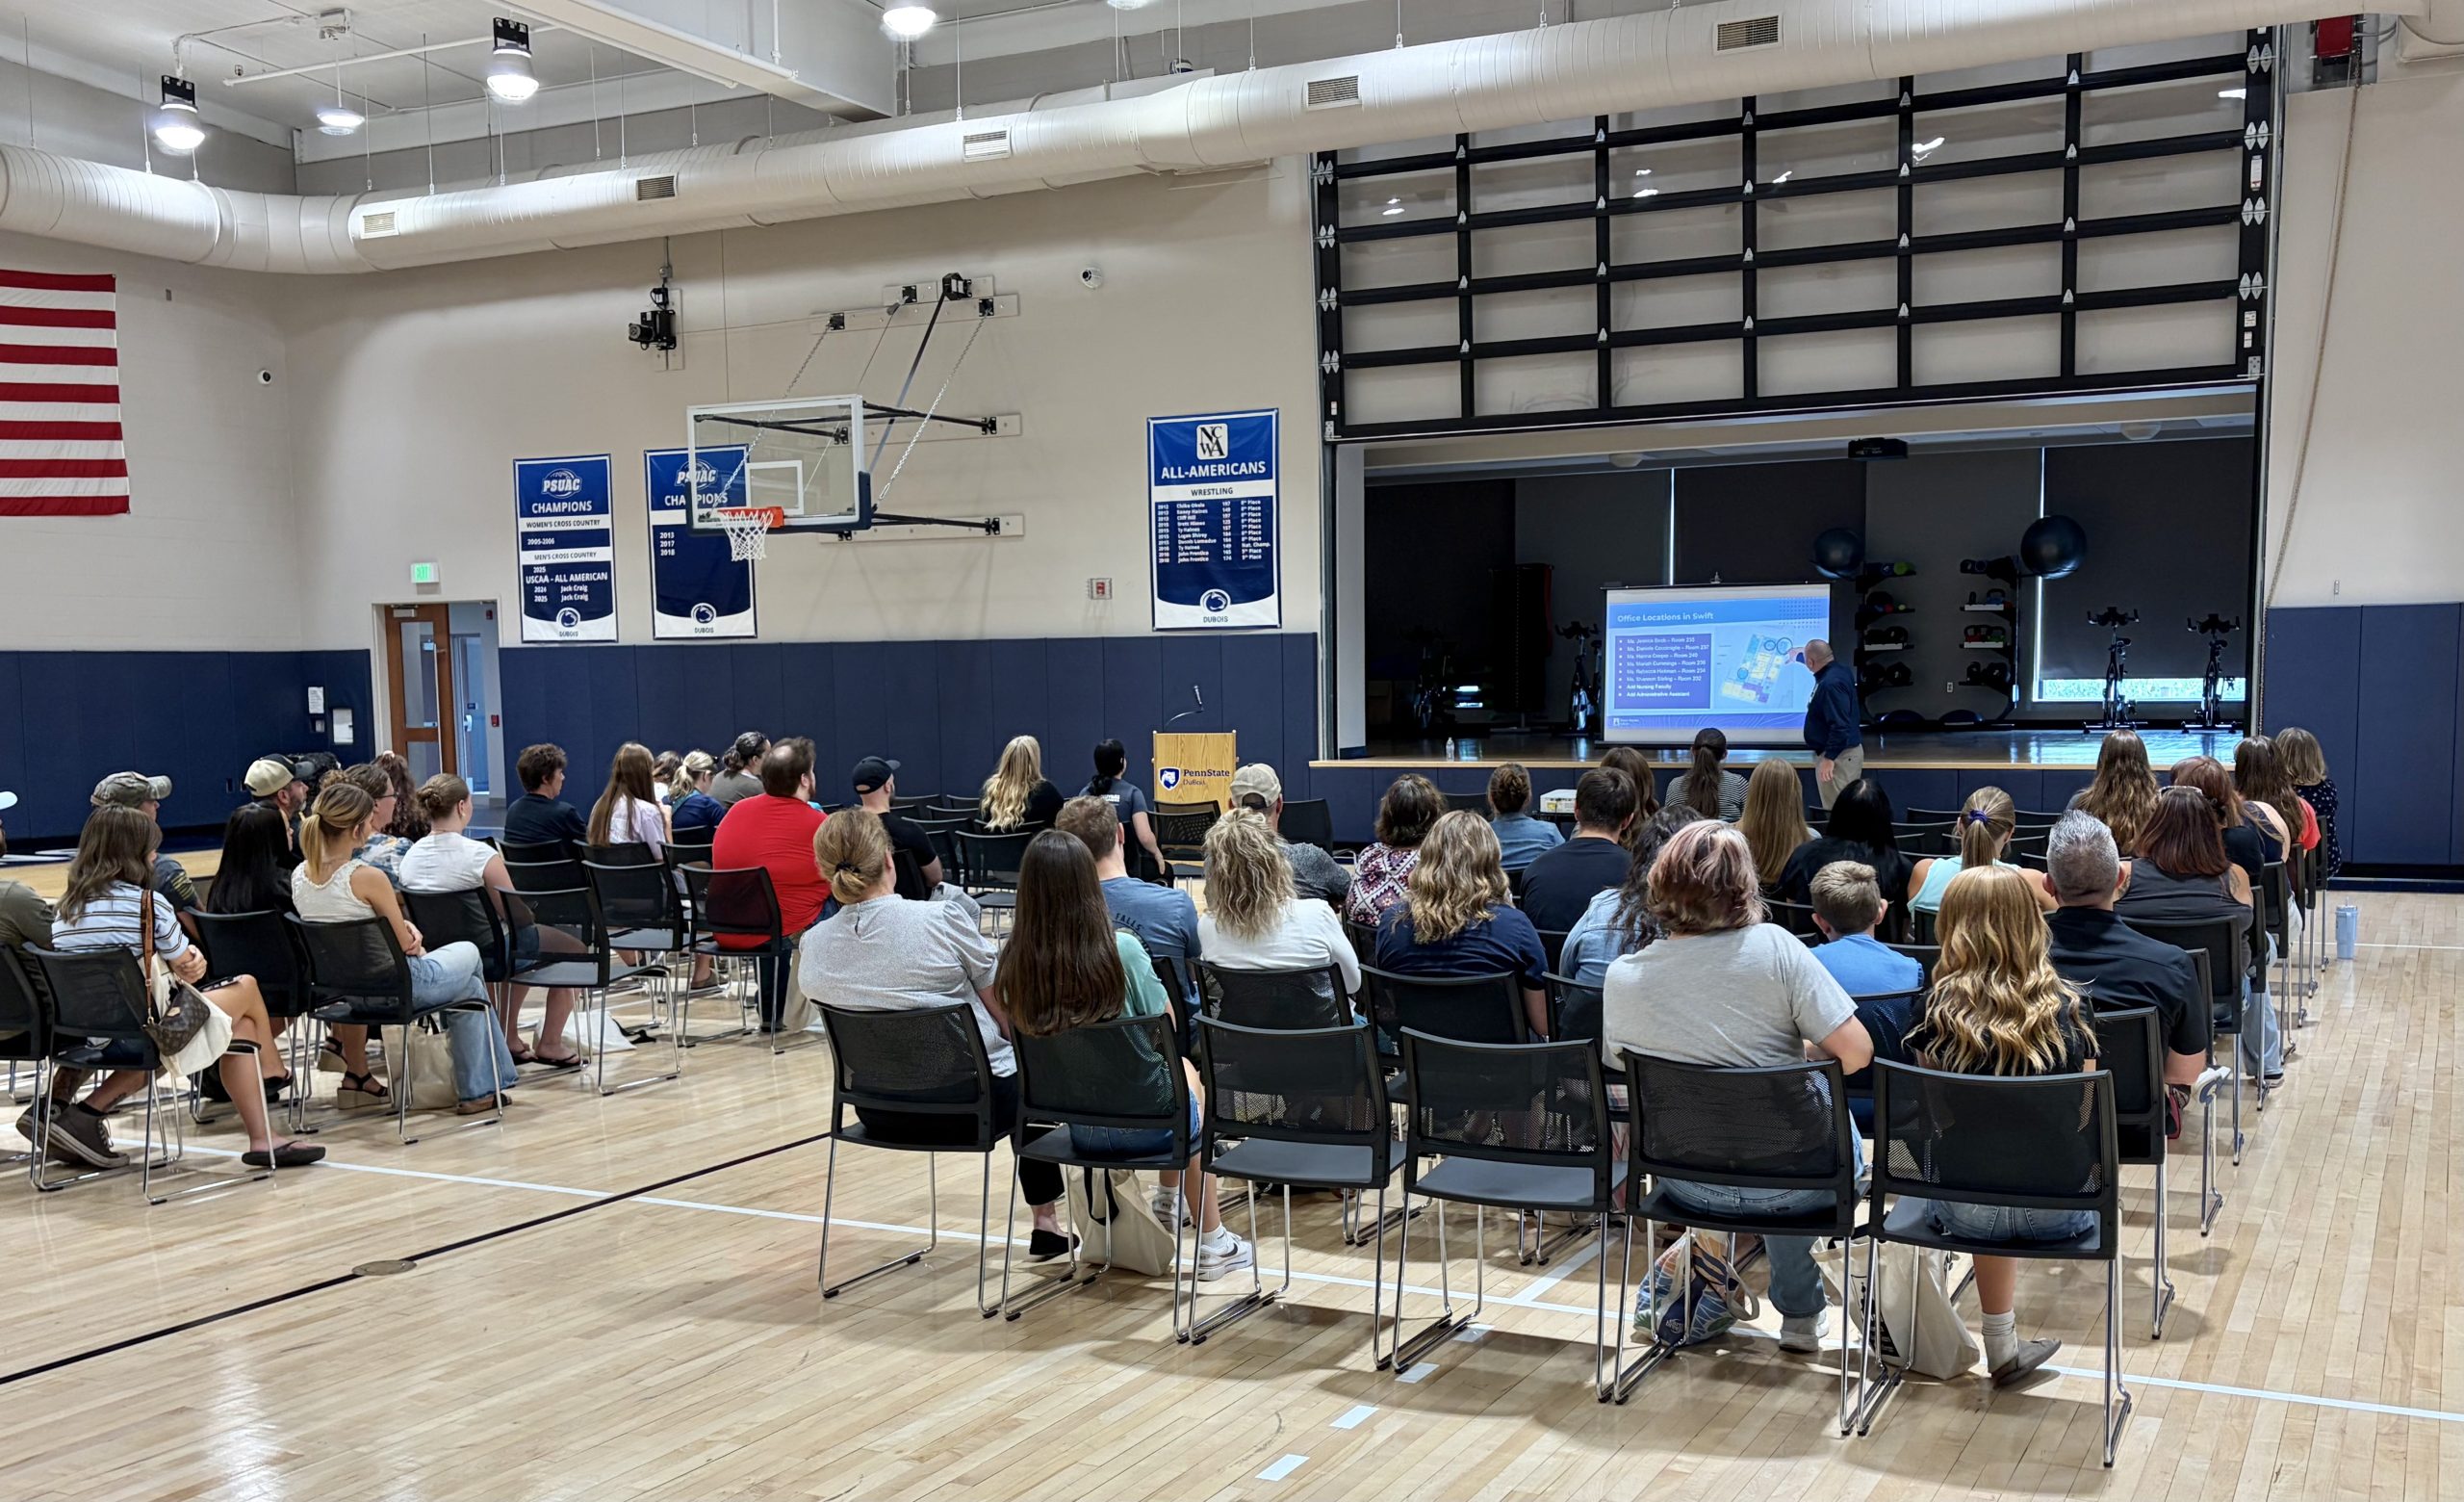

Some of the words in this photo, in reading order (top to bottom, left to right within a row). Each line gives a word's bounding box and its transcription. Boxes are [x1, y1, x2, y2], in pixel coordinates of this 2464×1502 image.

[1161, 461, 1266, 479] ALL-AMERICANS
[543, 479, 580, 492] PSUAC
[1191, 487, 1233, 496] WRESTLING
[665, 493, 728, 506] CHAPIONS
[532, 500, 592, 513] CHAMPIONS
[526, 575, 549, 584] USCAA
[569, 572, 608, 582] AMERICAN
[1115, 913, 1142, 931] FALLS
